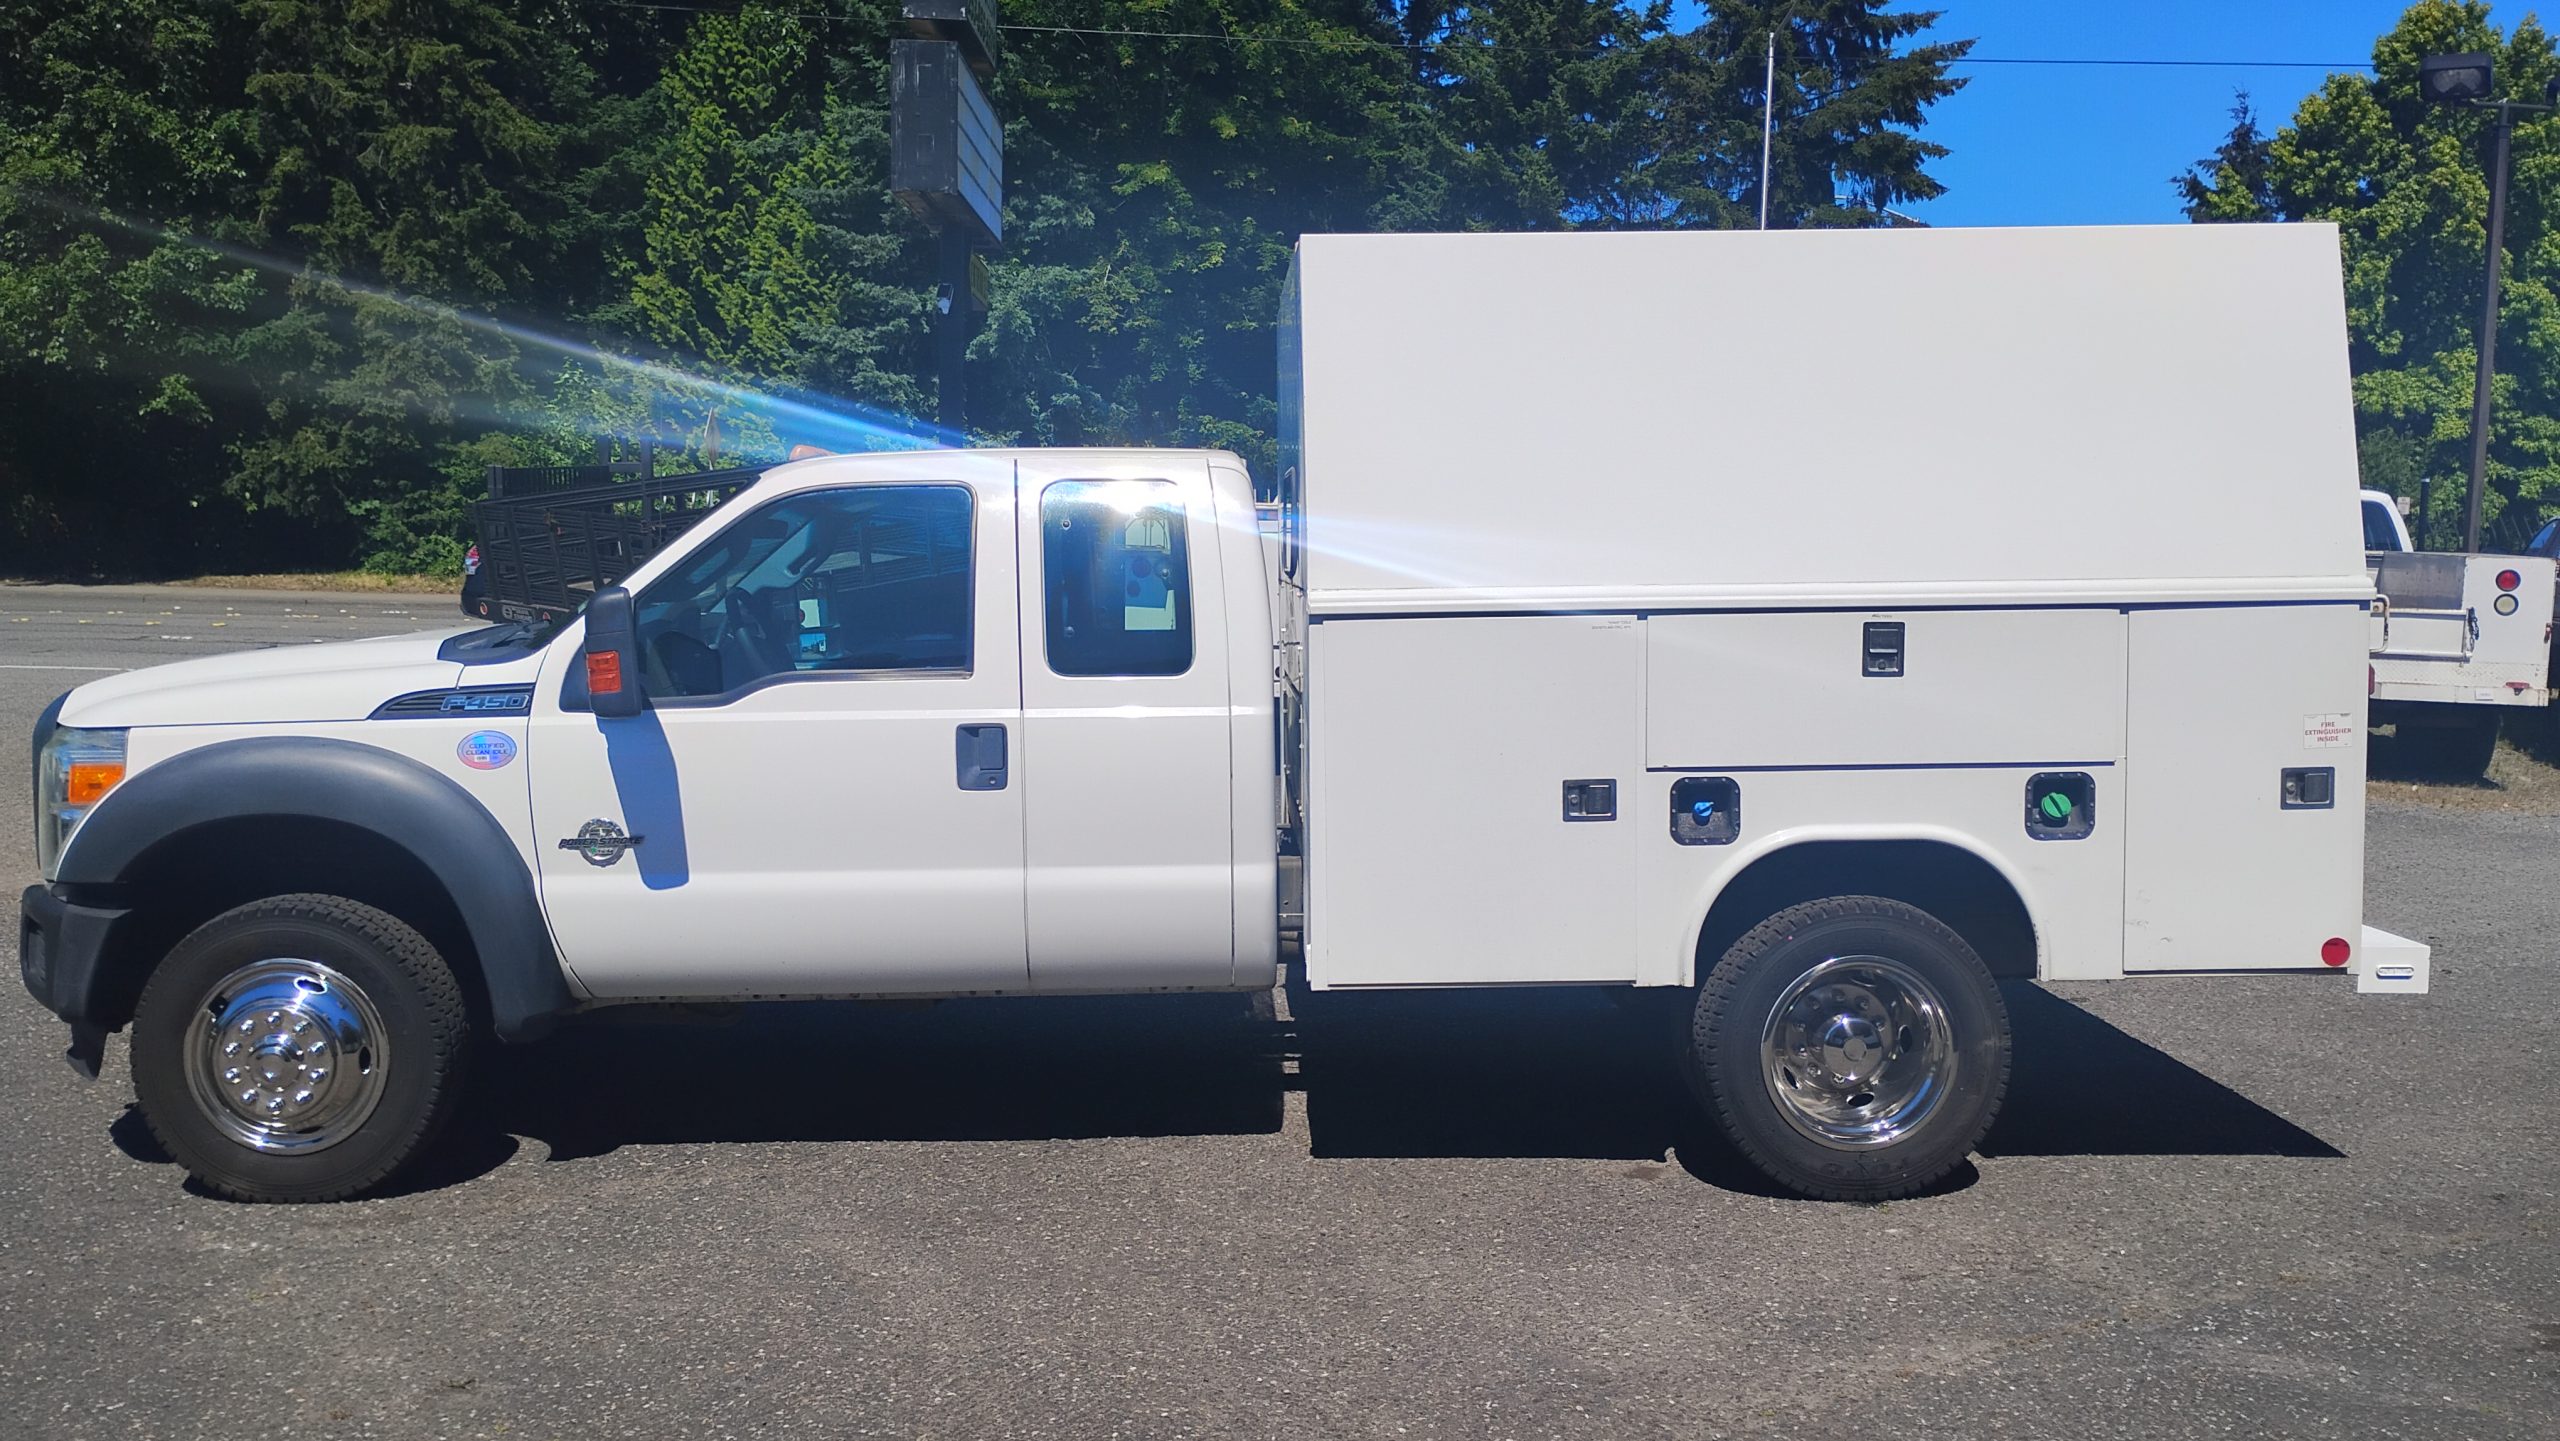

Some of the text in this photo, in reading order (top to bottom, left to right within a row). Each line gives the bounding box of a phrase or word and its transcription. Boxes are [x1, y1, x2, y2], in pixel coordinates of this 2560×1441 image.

[440, 694, 530, 711] F-450
[2304, 727, 2352, 736] EXTINGUISHER
[558, 835, 645, 850] POWER STROKE
